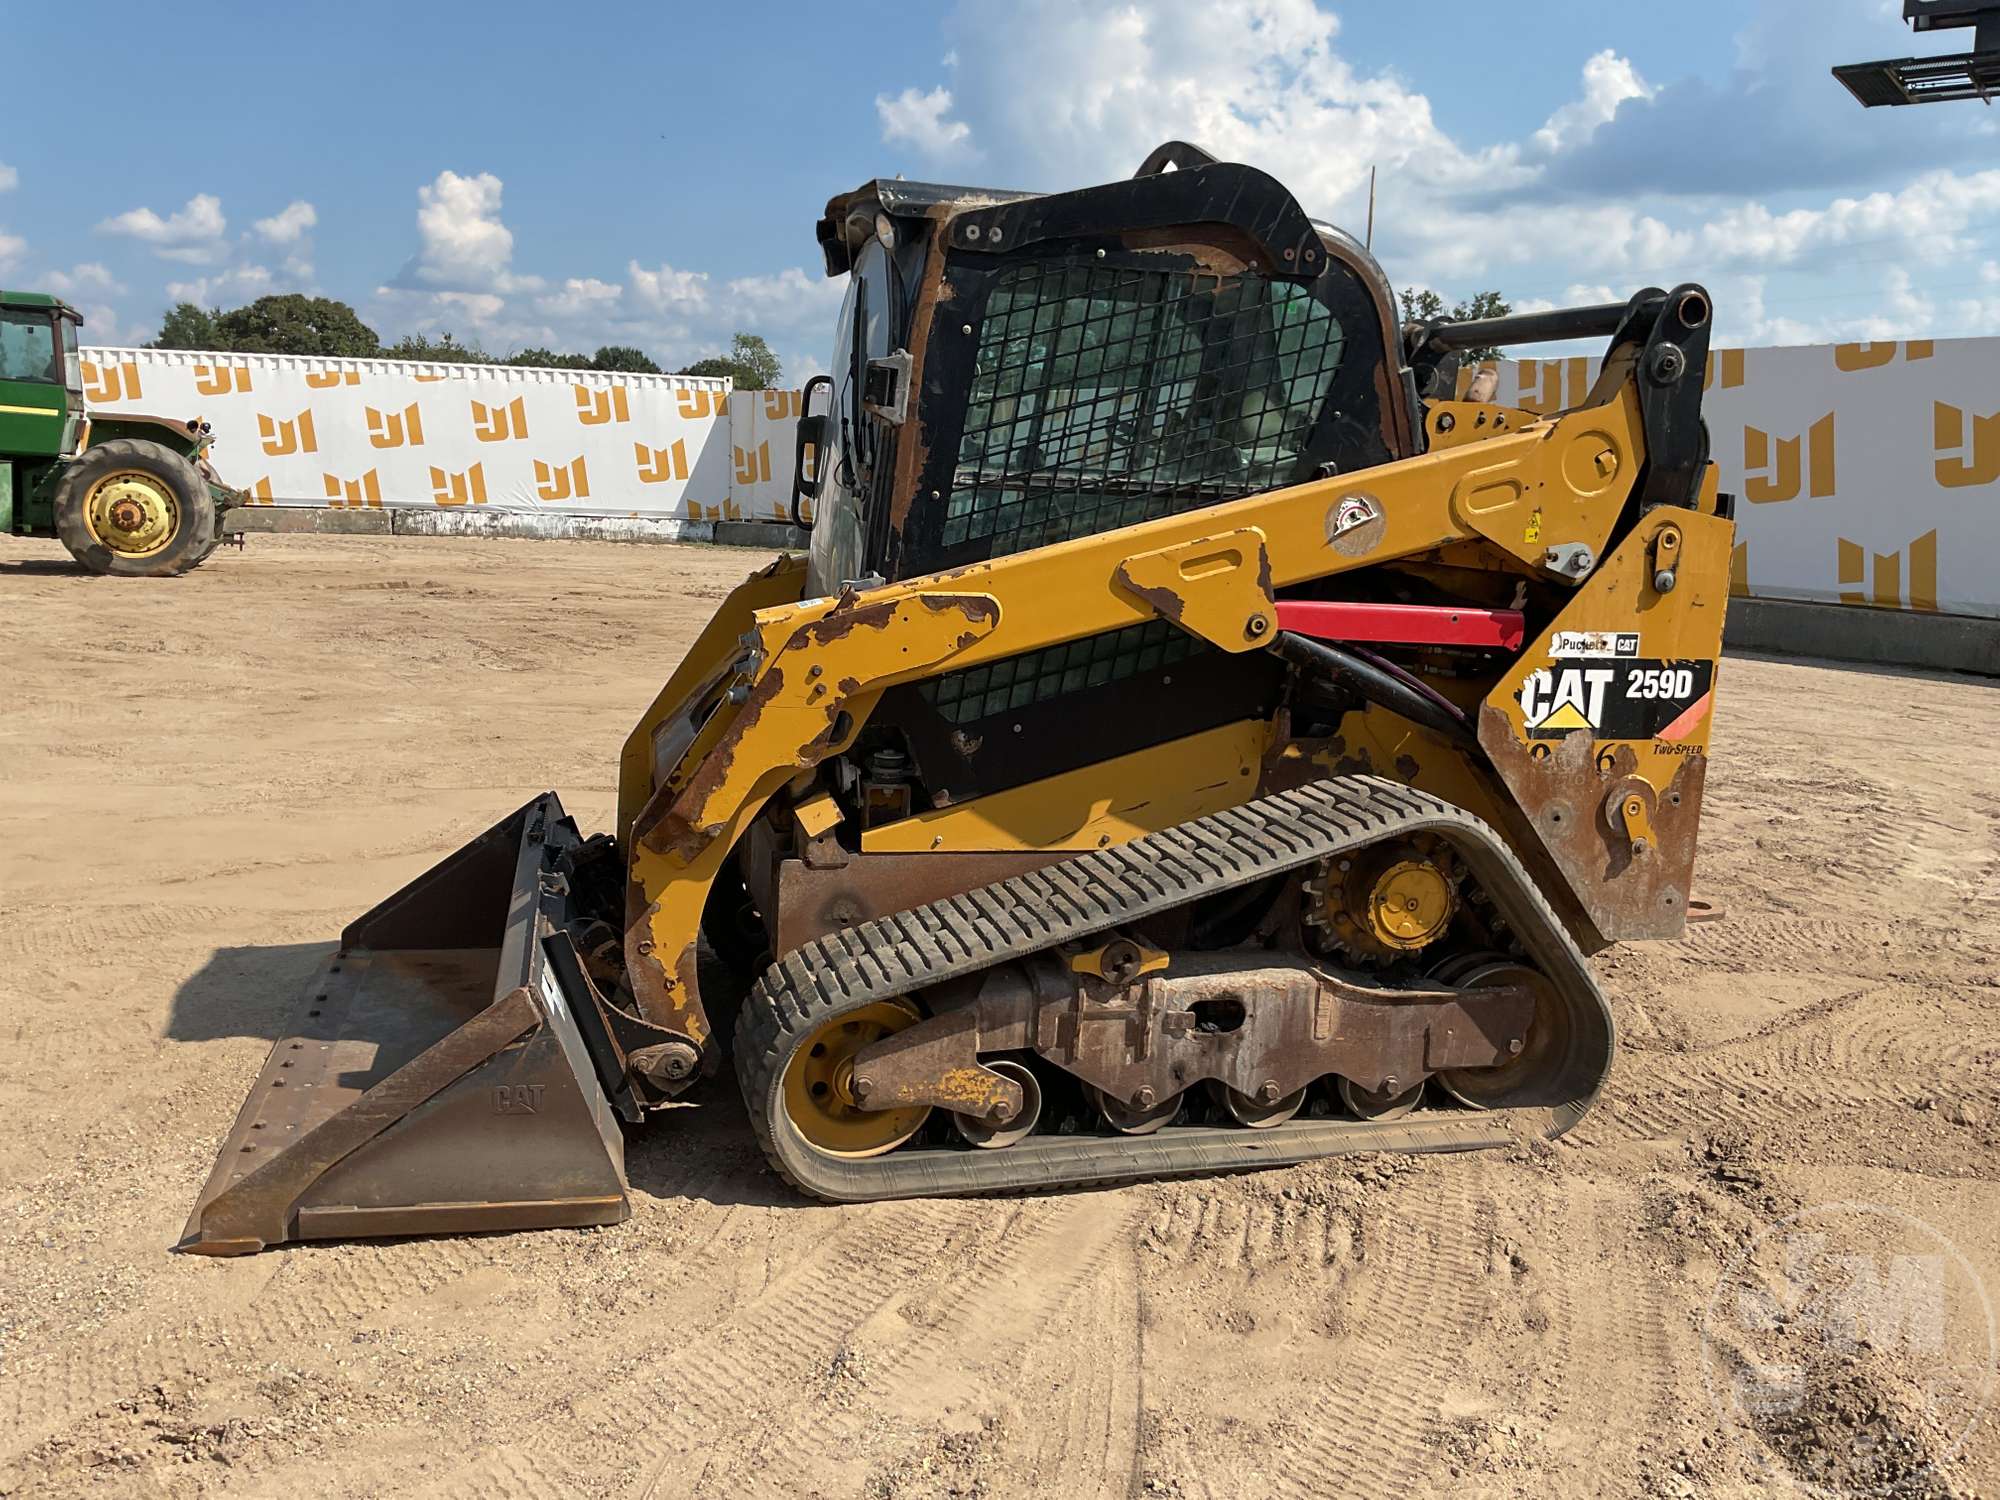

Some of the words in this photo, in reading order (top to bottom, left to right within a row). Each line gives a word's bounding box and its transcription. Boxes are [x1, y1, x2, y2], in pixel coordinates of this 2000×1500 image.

[1617, 638, 1637, 651] CAT
[1520, 669, 1614, 729] CAT
[1626, 669, 1693, 699] 259D
[493, 1084, 545, 1114] CAT
